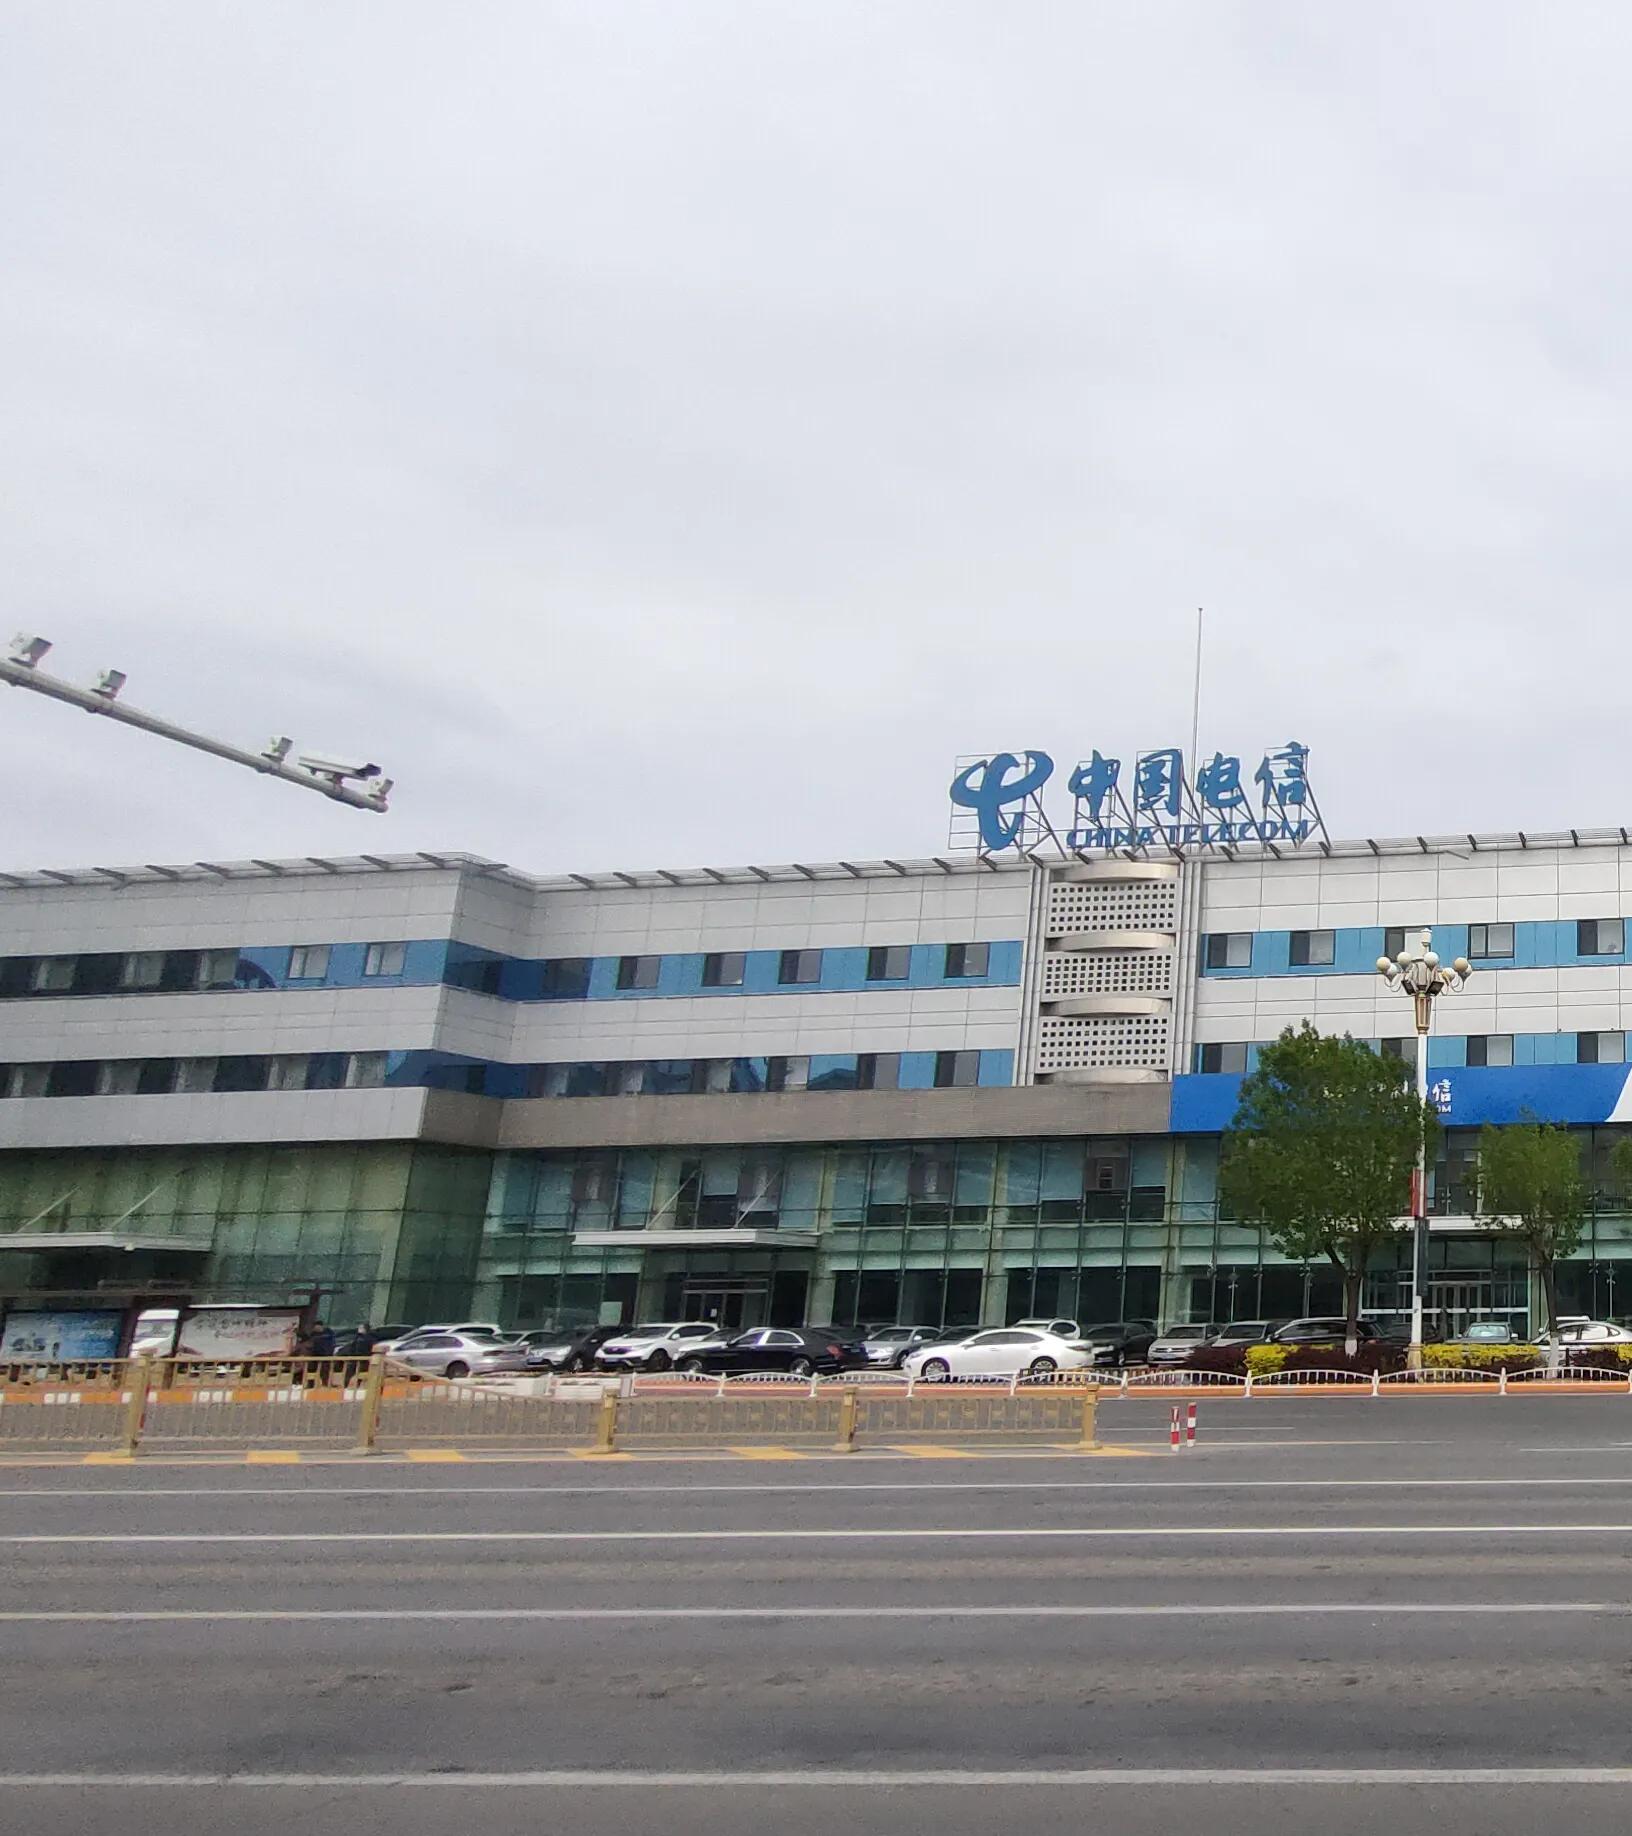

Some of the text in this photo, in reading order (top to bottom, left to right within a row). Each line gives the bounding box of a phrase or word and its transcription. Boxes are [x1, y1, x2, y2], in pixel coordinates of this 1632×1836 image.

[1068, 741, 1310, 821] 中国电信
[1066, 819, 1310, 849] CHINA TELECOM
